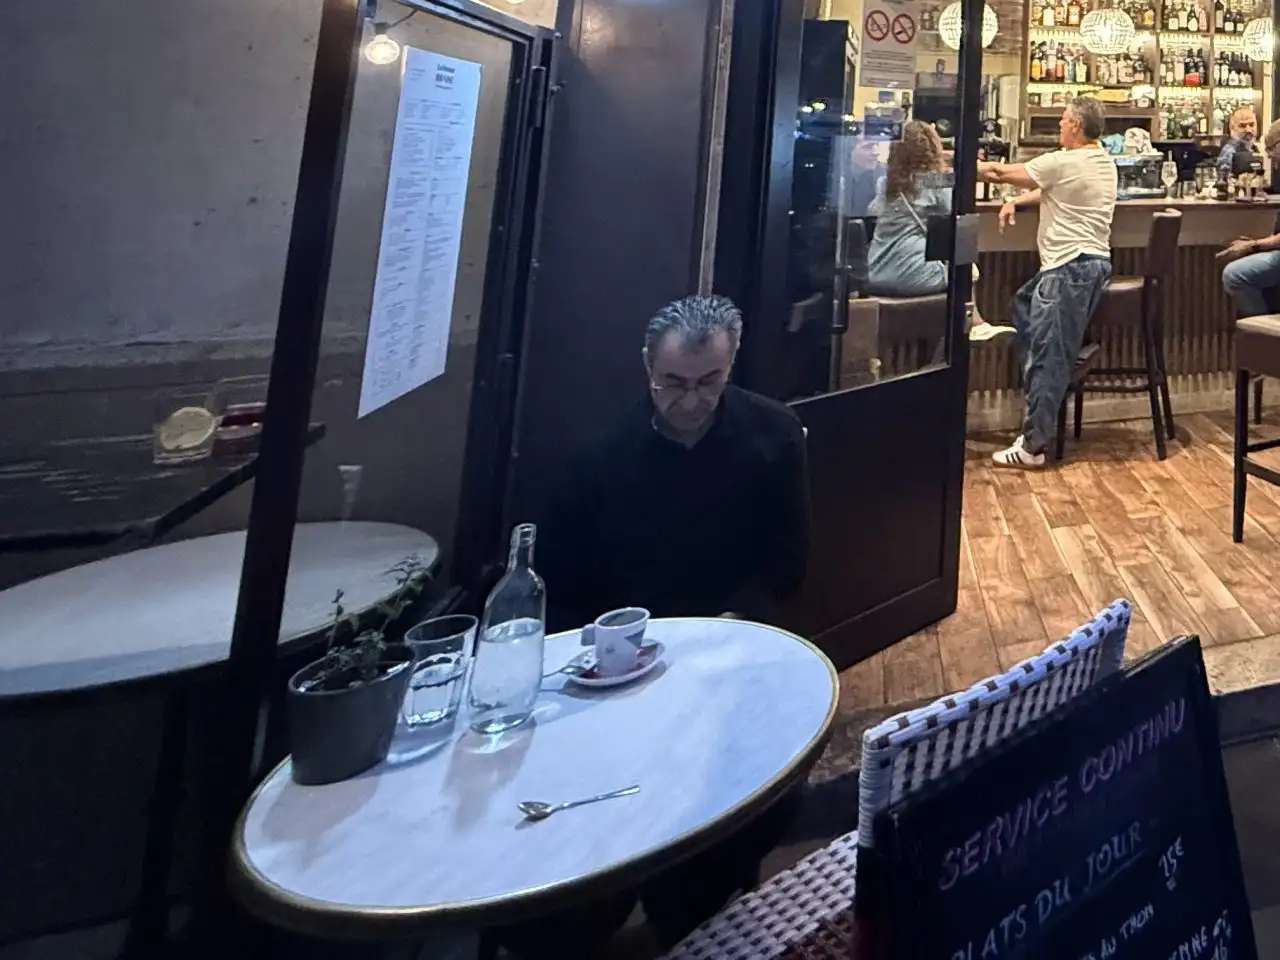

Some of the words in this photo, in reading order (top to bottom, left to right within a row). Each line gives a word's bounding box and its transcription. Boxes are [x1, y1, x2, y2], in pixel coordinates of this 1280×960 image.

[938, 775, 1069, 890] SERVICE
[1080, 697, 1185, 792] CONTINU
[1034, 876, 1072, 924] DU
[1085, 820, 1142, 889] JOUR
